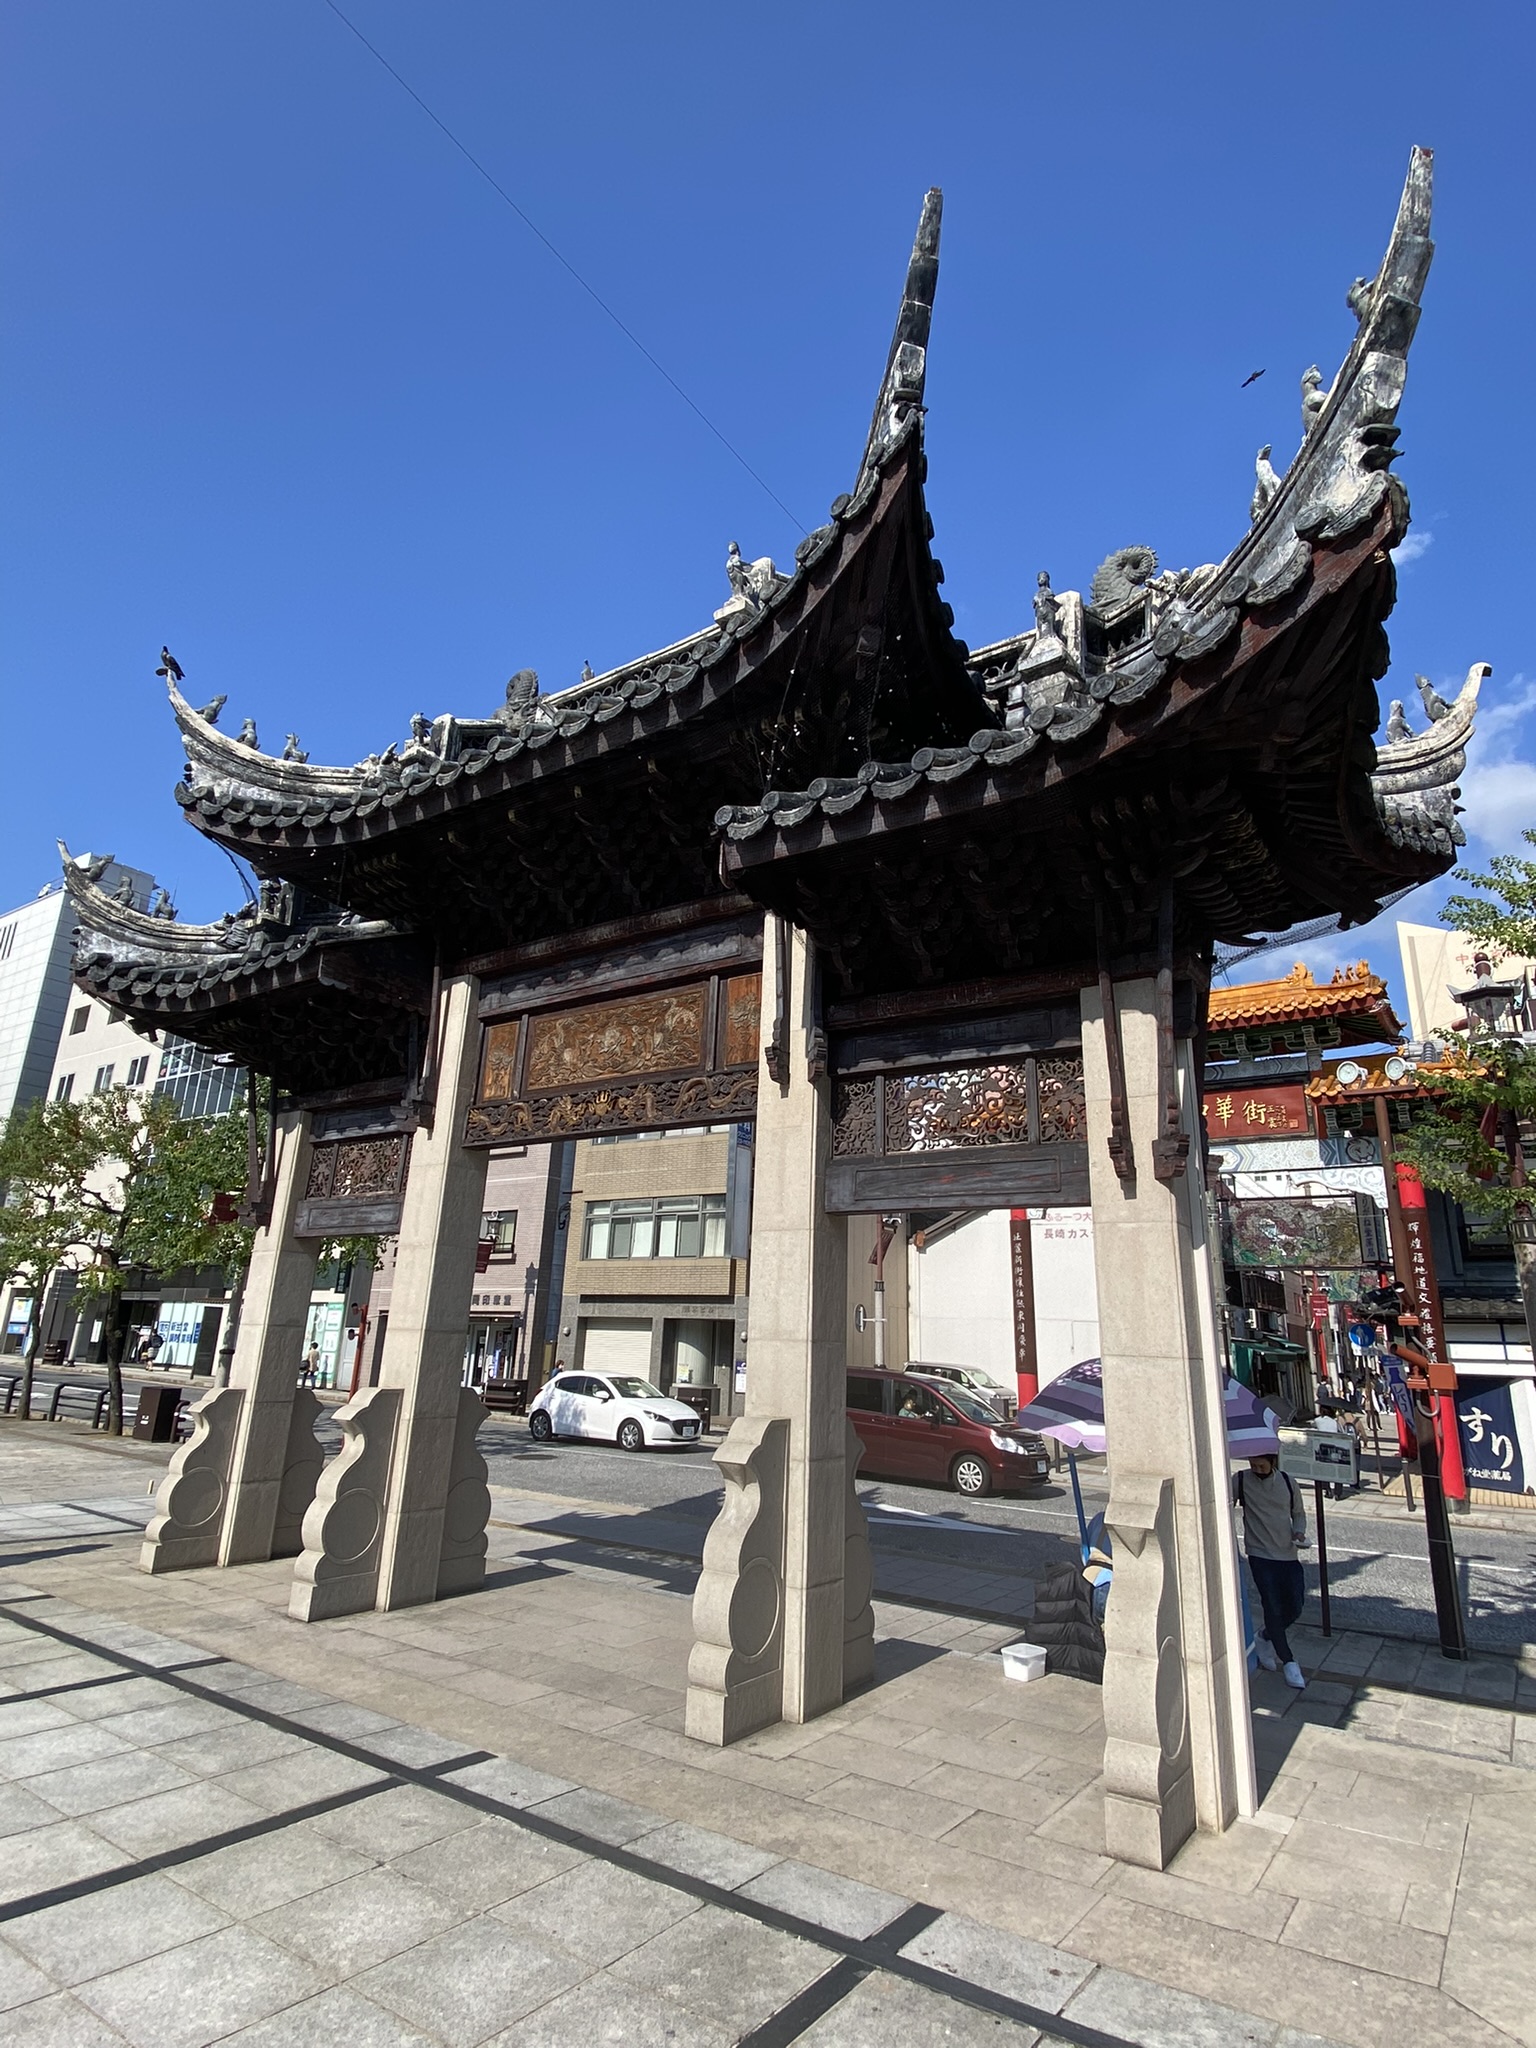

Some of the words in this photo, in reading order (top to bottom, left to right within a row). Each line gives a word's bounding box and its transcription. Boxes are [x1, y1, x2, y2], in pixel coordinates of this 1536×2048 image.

[1202, 1094, 1267, 1129] 華街
[1044, 1228, 1095, 1239] 長崎カス
[1458, 1406, 1514, 1469] すり
